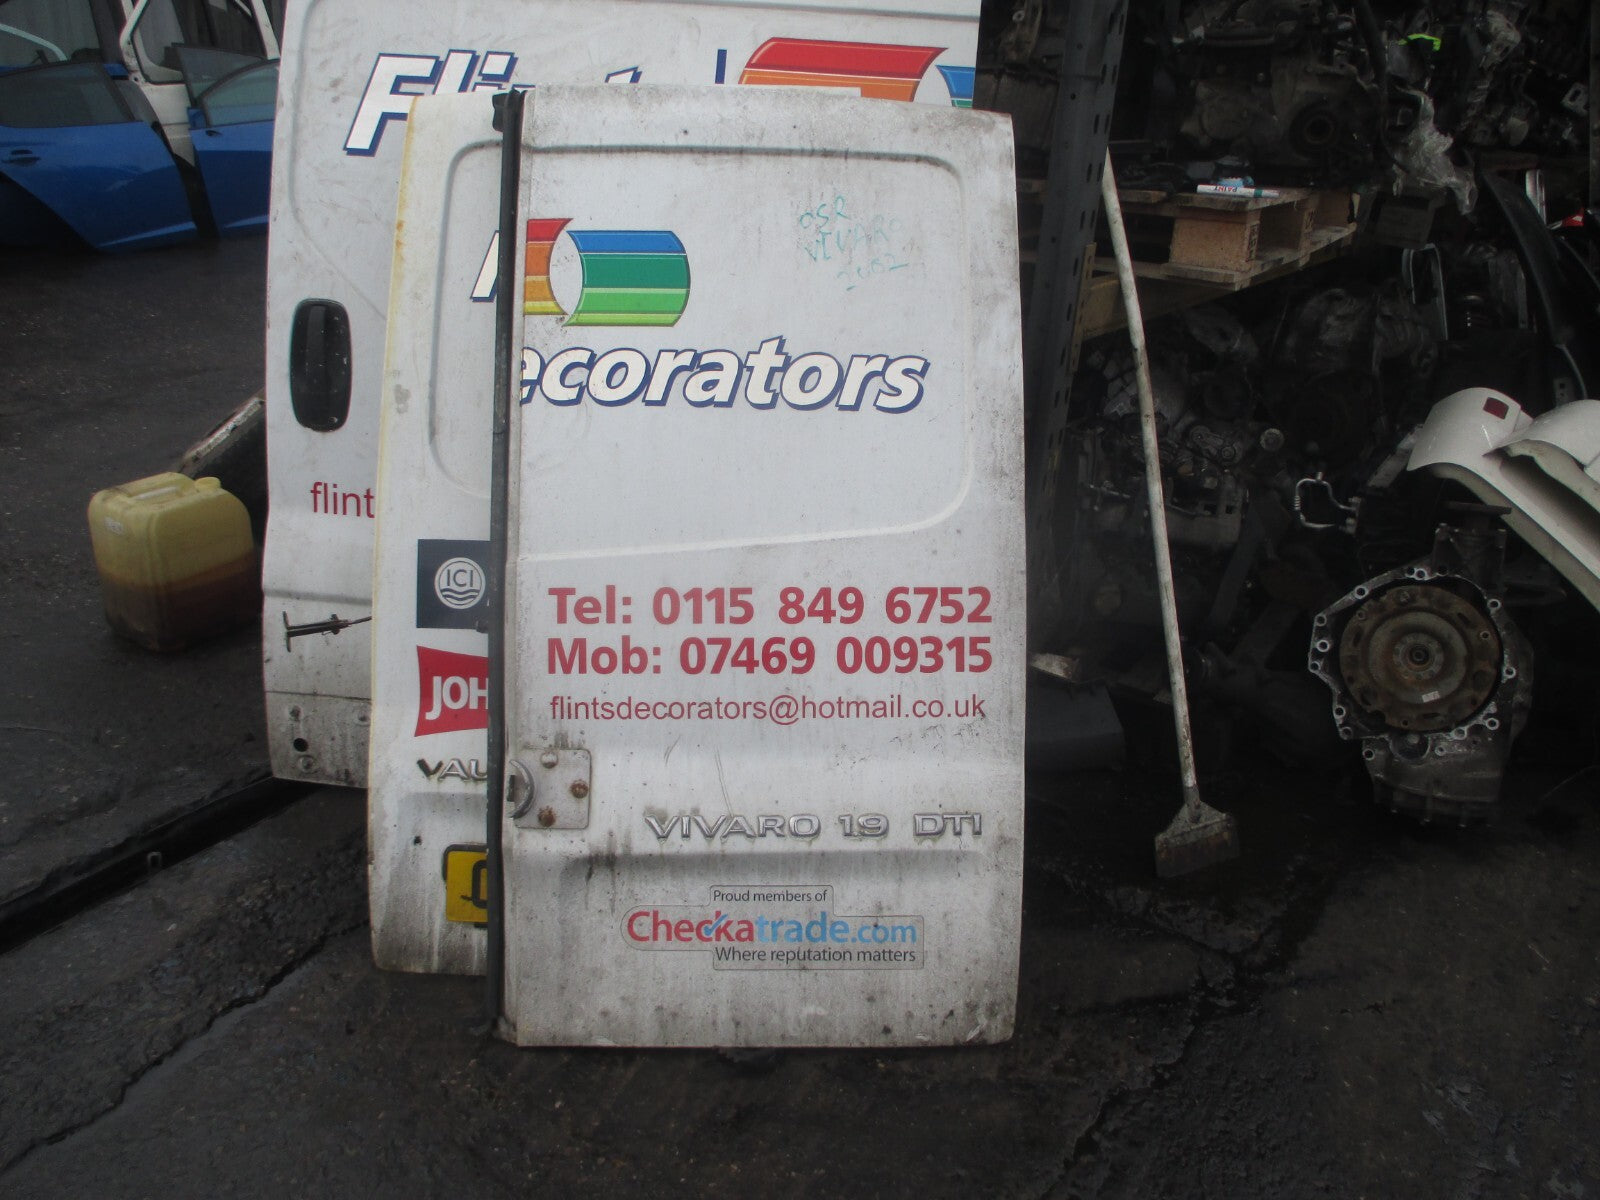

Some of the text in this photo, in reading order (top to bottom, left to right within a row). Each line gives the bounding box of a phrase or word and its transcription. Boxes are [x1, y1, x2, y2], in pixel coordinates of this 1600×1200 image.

[310, 481, 375, 518] flint
[446, 568, 474, 588] ICI
[548, 585, 993, 626] Tel: 0115 849 6752
[547, 635, 993, 675] Mob: 07469 009315
[550, 694, 986, 726] flintsdecorators@hotmail.co.uk
[645, 812, 822, 839] VIVARO
[912, 812, 983, 837] DTI
[713, 889, 828, 902] Proud members of
[626, 909, 918, 944] Checkatrade.com
[715, 946, 917, 965] Where reputation matters
